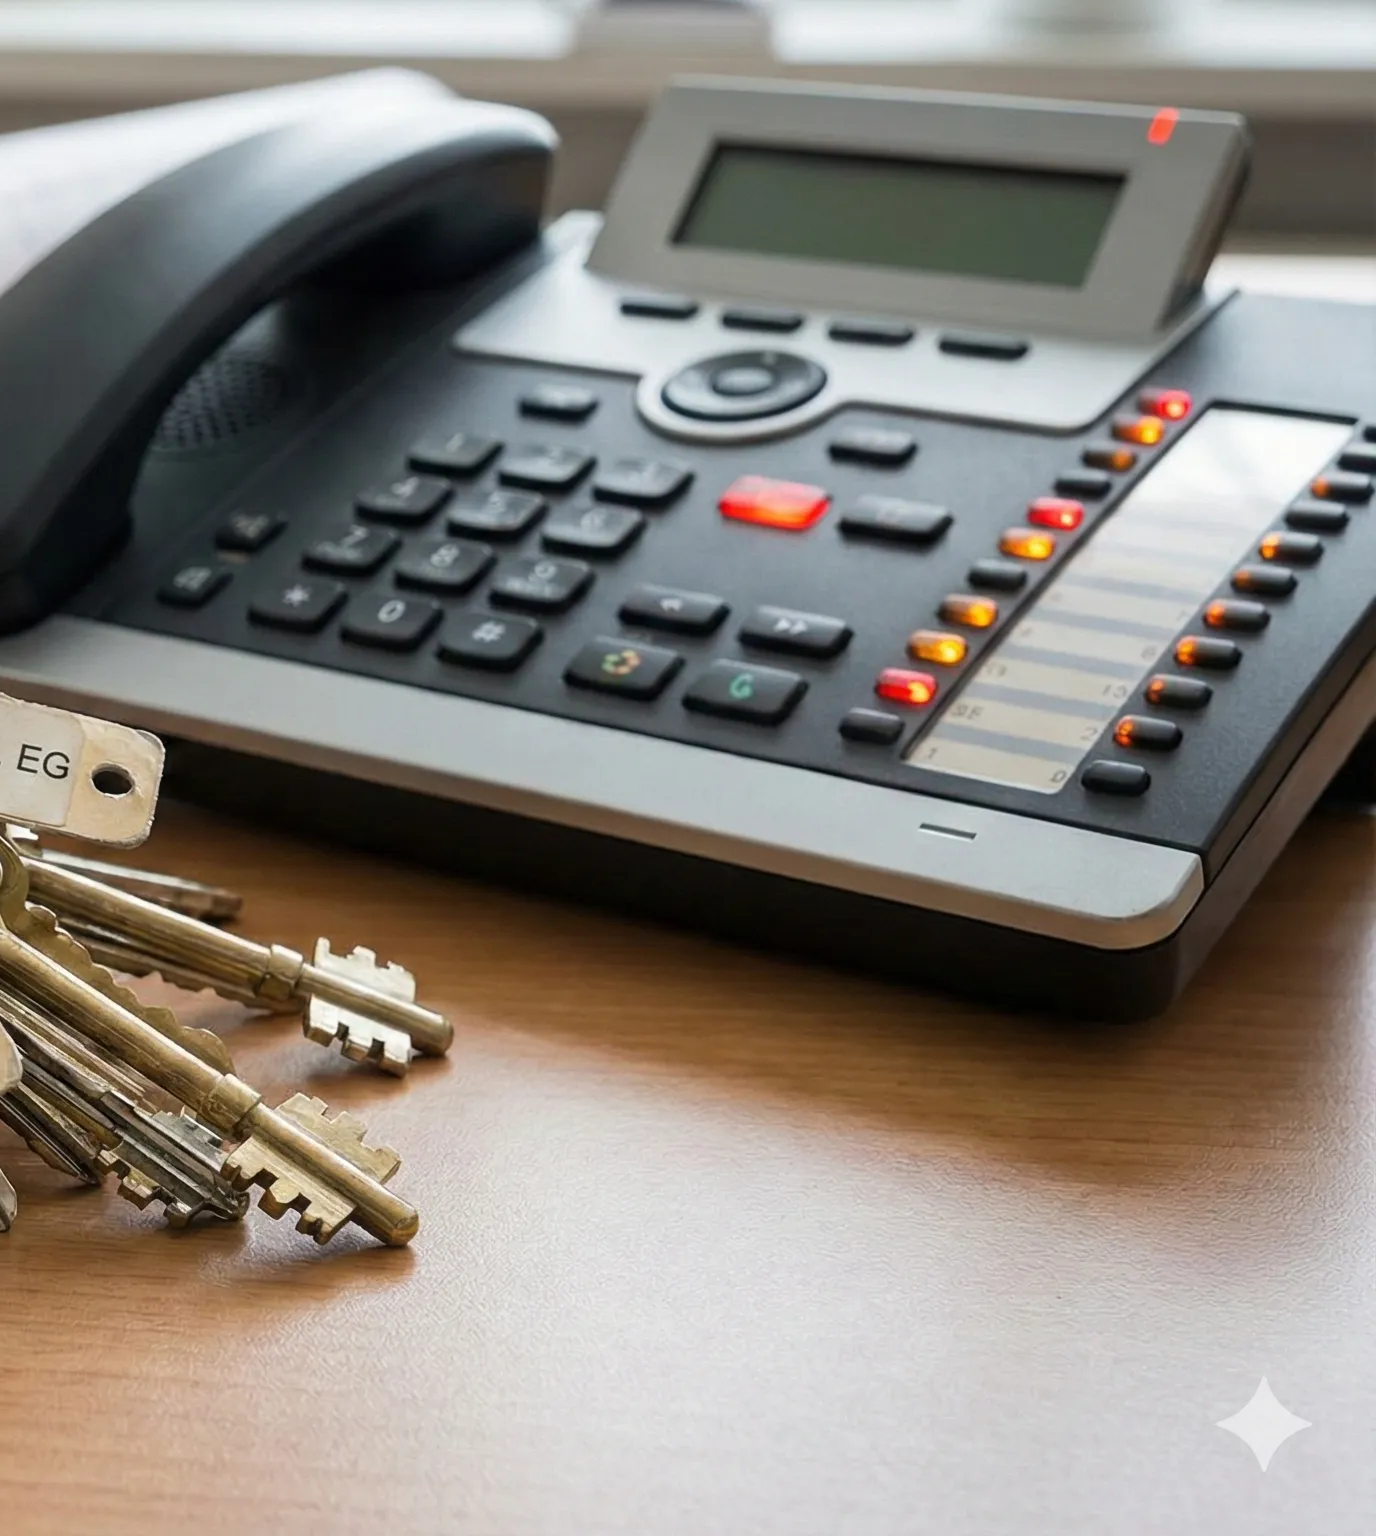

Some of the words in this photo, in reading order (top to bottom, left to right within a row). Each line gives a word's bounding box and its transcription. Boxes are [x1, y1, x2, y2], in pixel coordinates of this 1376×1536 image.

[430, 543, 460, 568] 8
[377, 598, 407, 624] 0
[17, 743, 71, 780] EG
